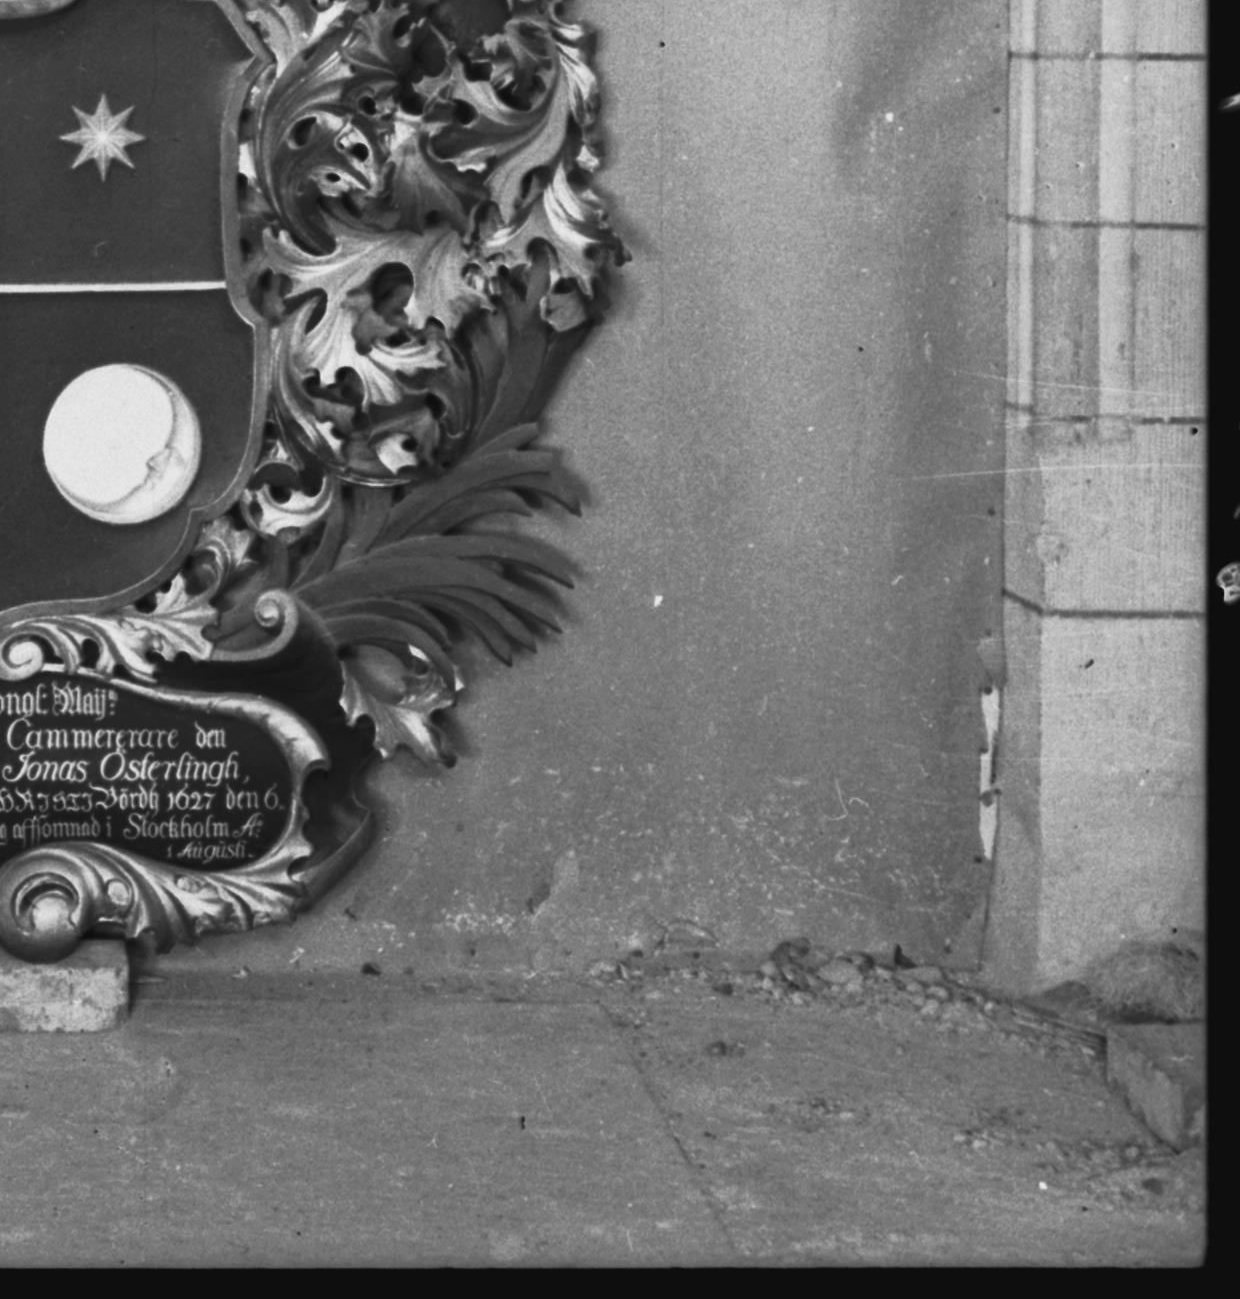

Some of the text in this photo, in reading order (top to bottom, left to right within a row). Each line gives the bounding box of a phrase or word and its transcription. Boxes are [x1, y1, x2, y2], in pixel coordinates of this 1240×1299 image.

[194, 720, 226, 748] den
[2, 751, 89, 782] Jonas
[167, 783, 215, 812] 1627
[226, 783, 258, 809] den
[123, 811, 229, 839] Stockholm
